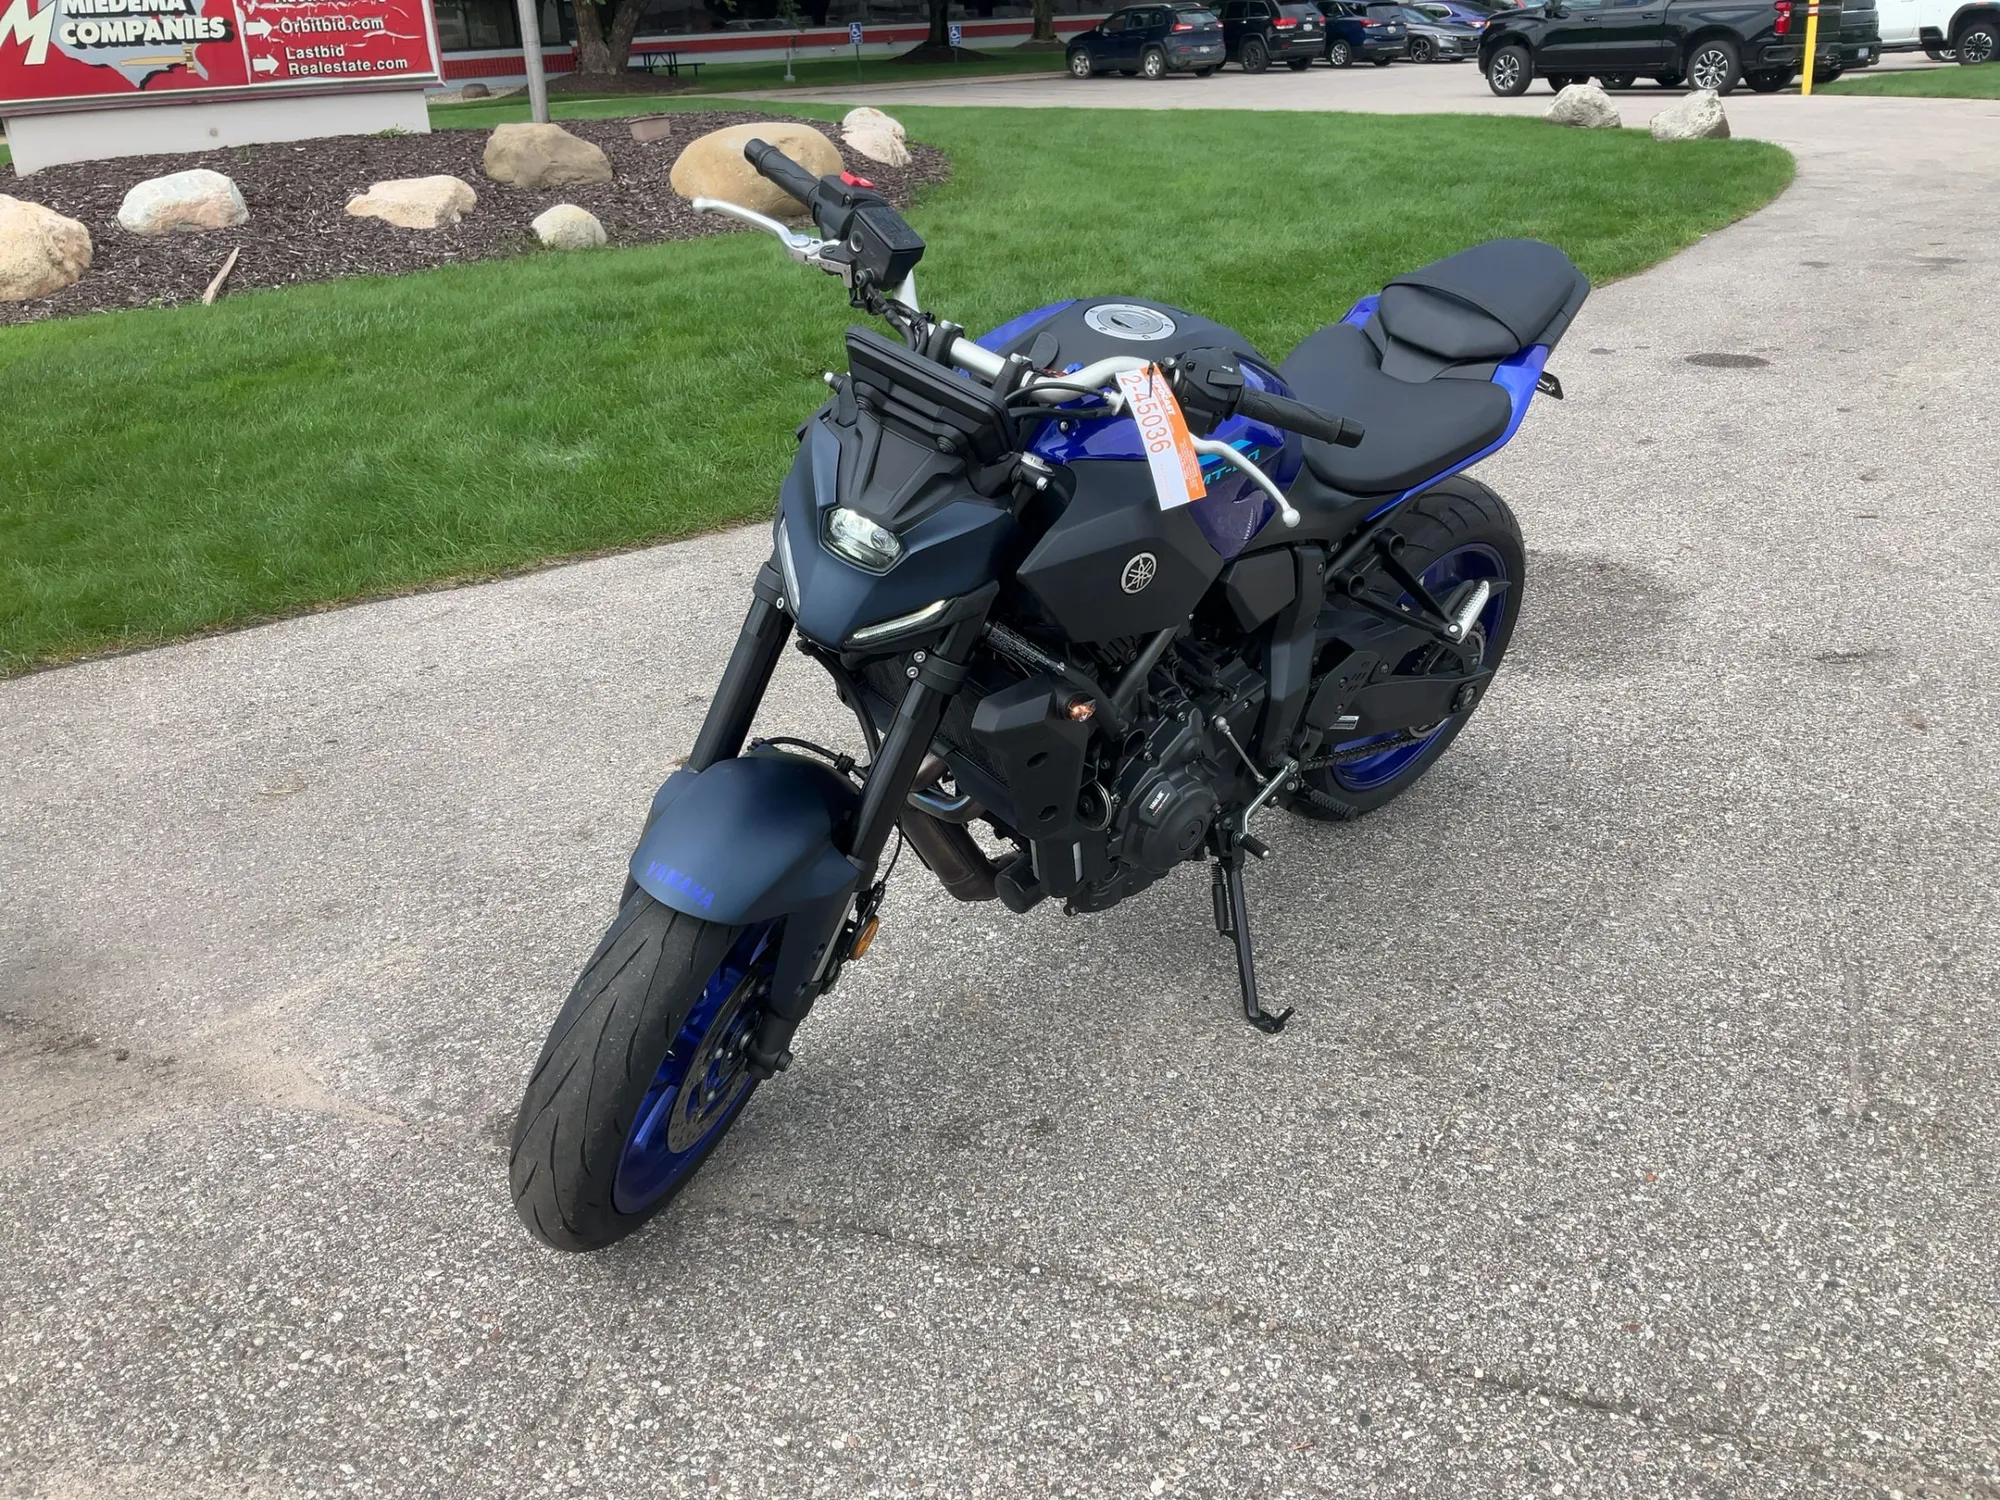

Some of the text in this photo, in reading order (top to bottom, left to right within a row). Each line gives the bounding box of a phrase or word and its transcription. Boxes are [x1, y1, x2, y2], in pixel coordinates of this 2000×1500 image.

[61, 0, 187, 14] MIEDEMA
[59, 17, 226, 45] COMPANIES
[280, 18, 385, 34] Orbitbid.com
[285, 44, 345, 60] Lastbid
[288, 59, 408, 76] Realestate.com
[1120, 375, 1172, 453] 2-45036
[645, 861, 715, 911] YAMAHA
